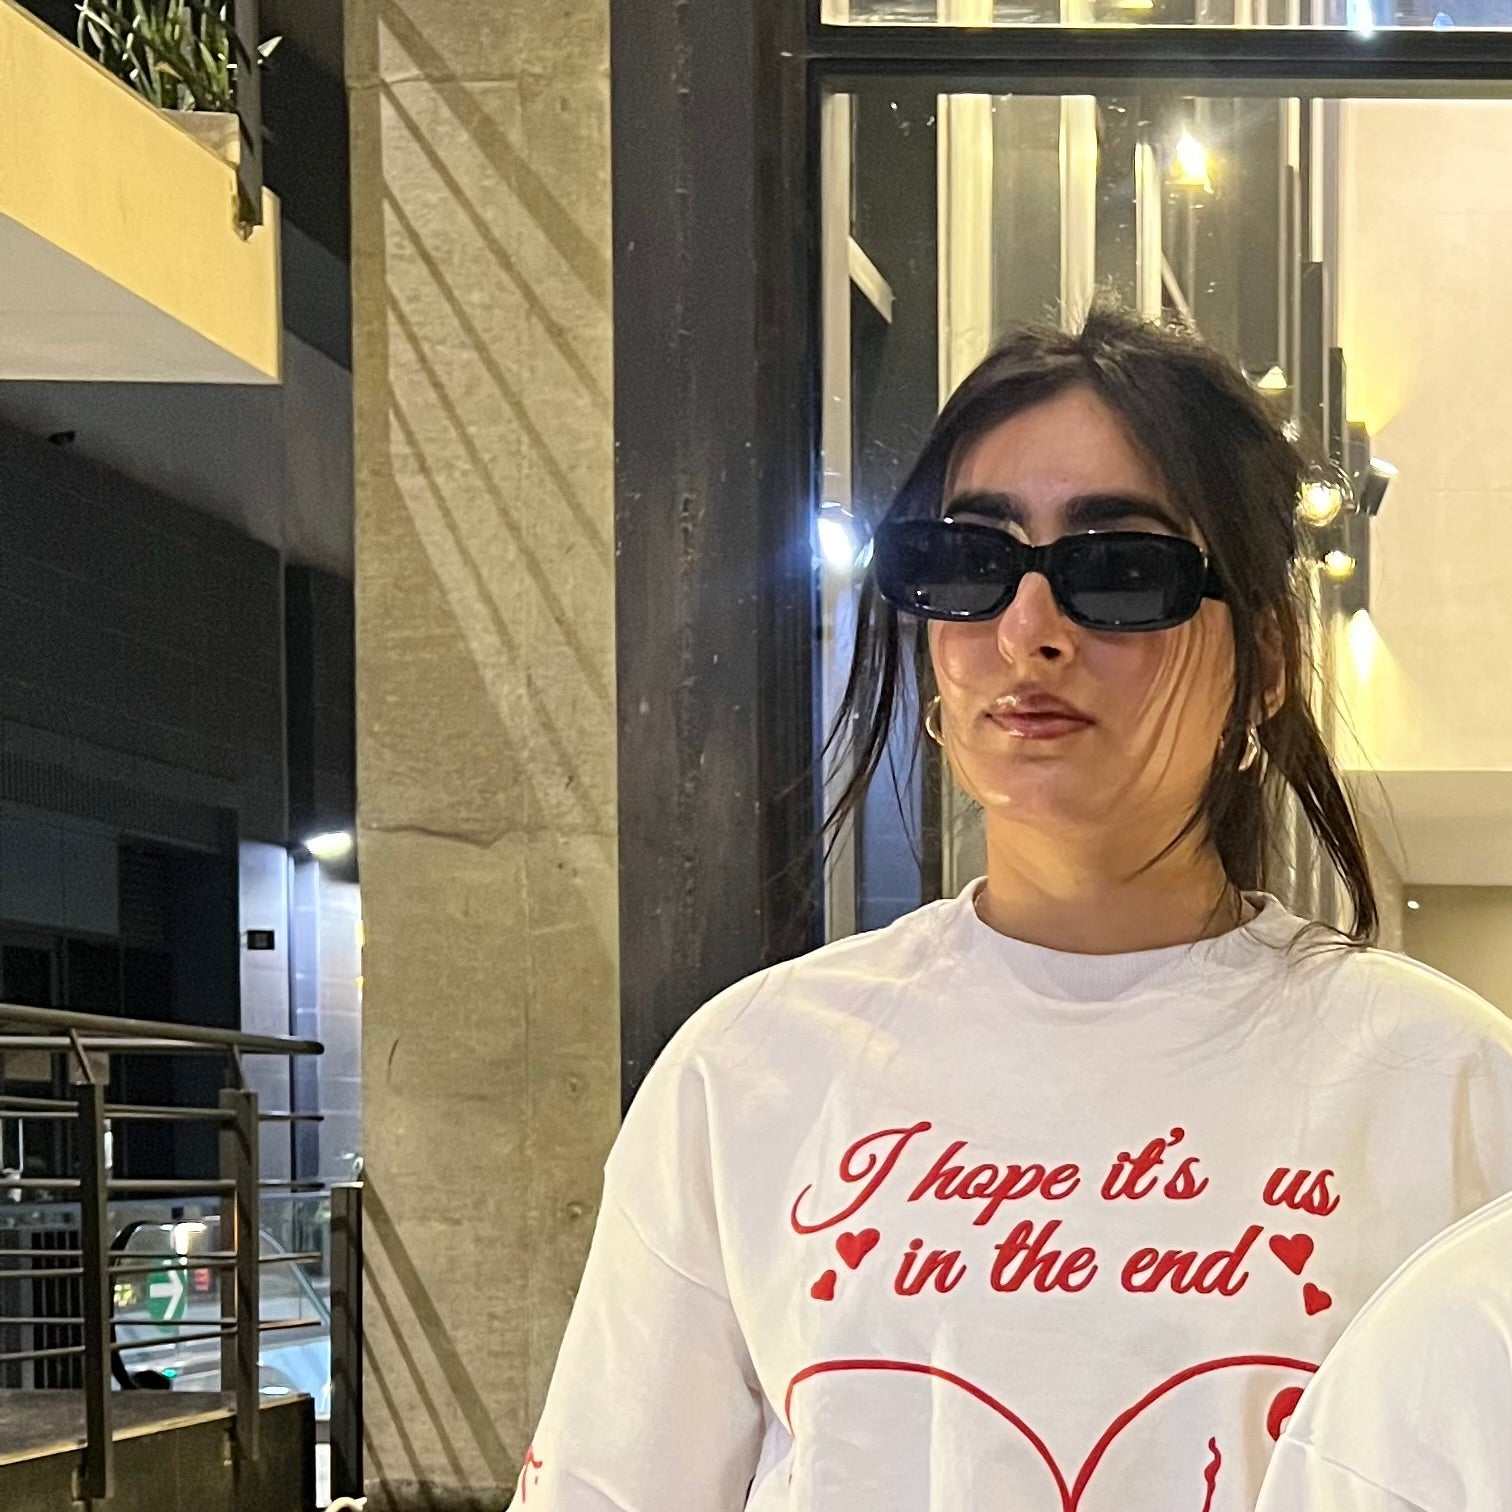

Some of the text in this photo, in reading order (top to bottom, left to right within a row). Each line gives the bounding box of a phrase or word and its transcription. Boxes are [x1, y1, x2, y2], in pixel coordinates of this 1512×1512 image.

[790, 1120, 1342, 1235] I hope it's us
[893, 1219, 1264, 1298] in the end
